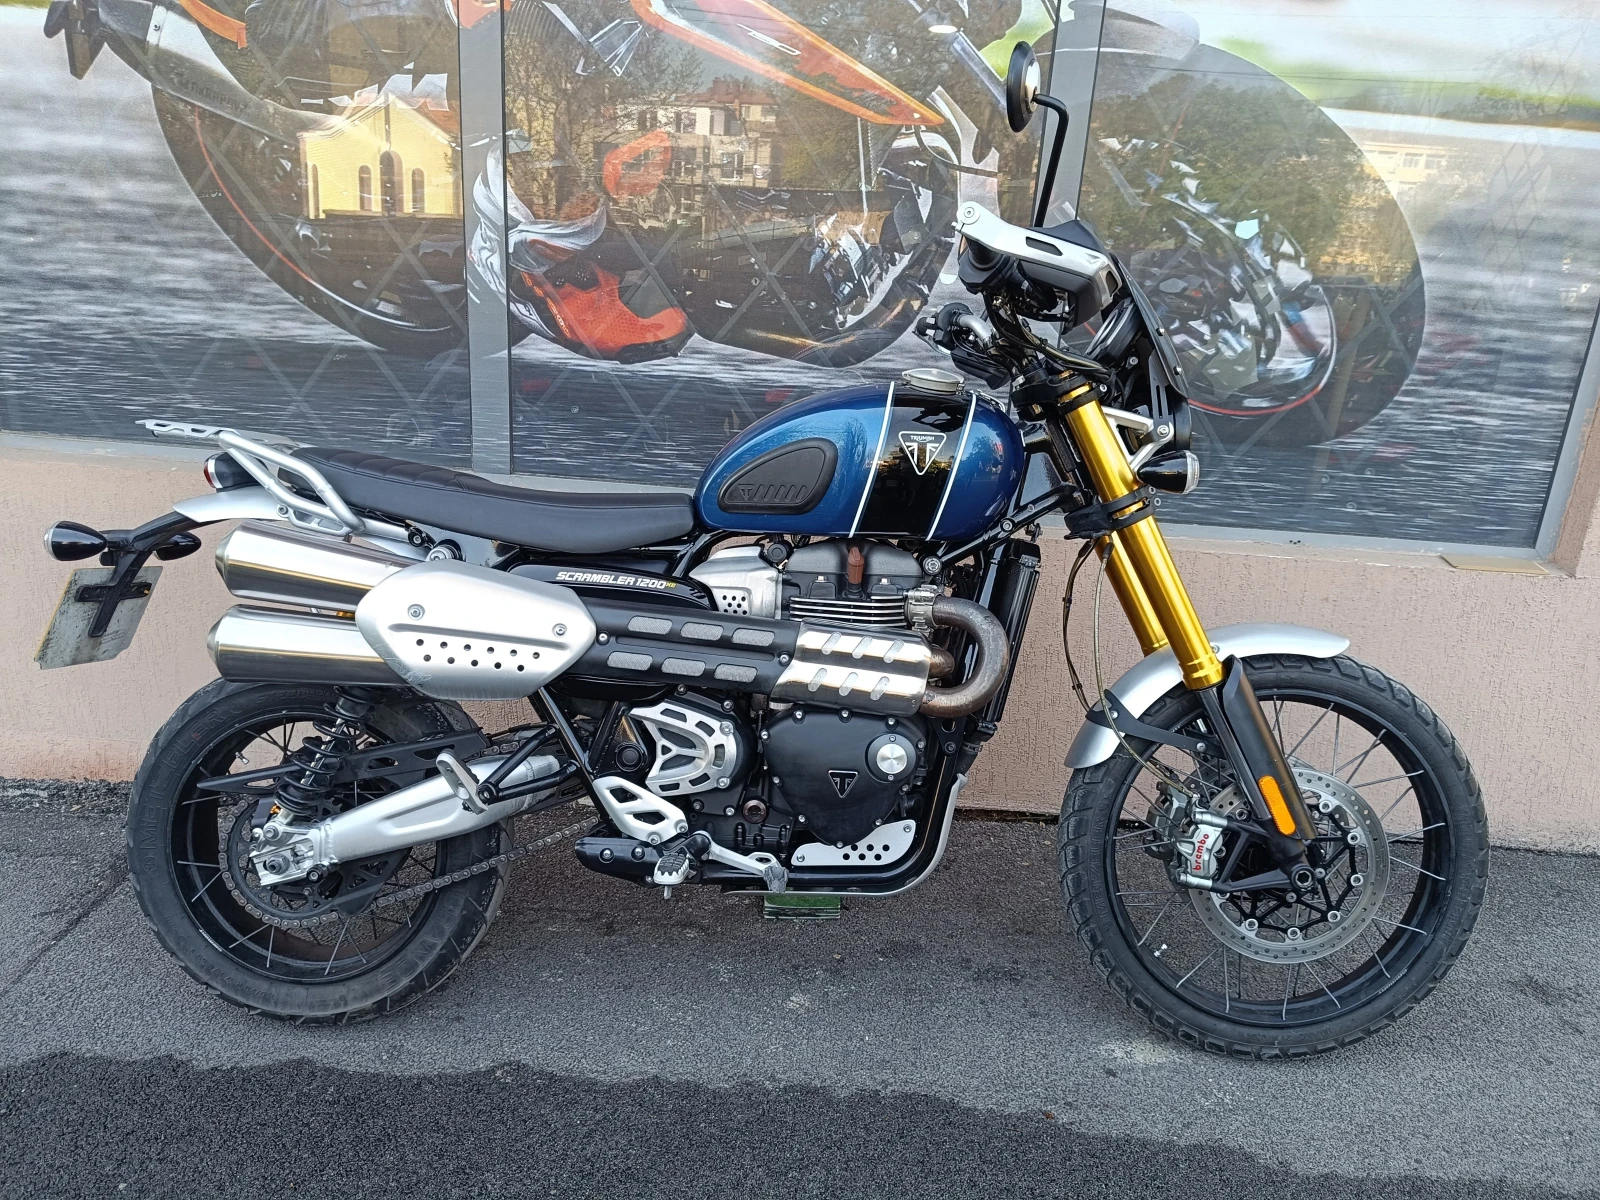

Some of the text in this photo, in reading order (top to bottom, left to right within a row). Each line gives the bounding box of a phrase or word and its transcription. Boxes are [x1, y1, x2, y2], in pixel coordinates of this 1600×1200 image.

[556, 571, 635, 585] SCRAMBLER
[636, 577, 666, 589] 1200
[139, 707, 226, 850] METZELER
[1091, 817, 1108, 918] METZELER
[1192, 833, 1209, 871] brembo
